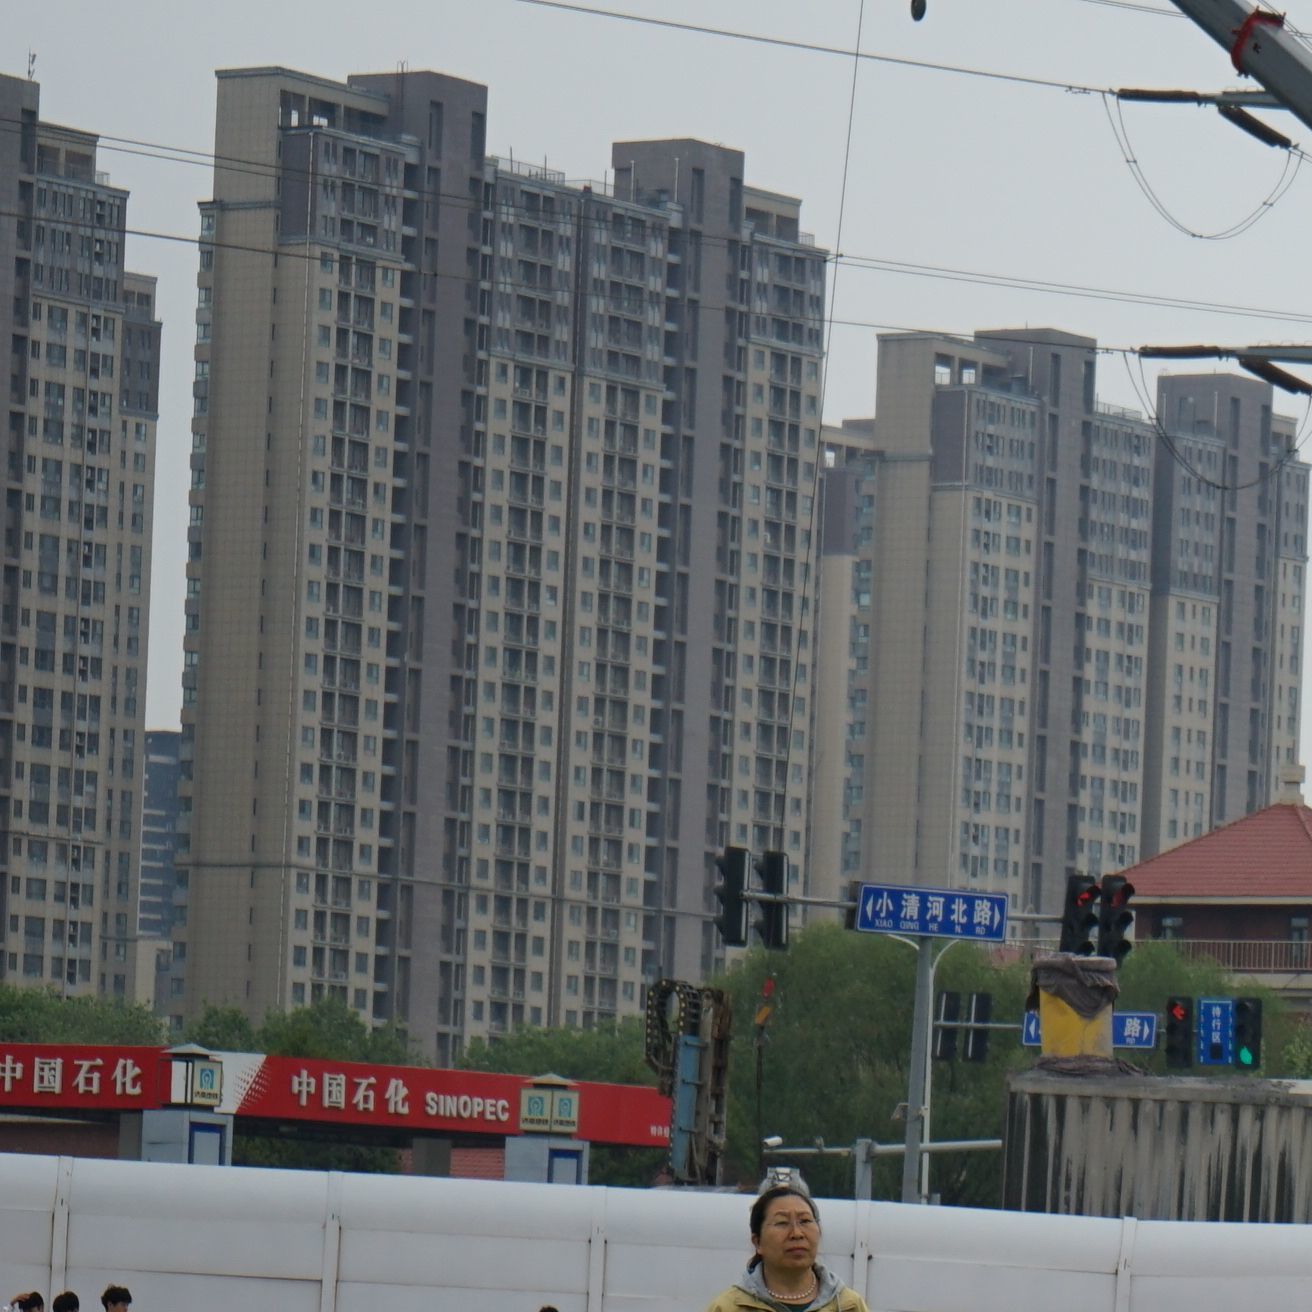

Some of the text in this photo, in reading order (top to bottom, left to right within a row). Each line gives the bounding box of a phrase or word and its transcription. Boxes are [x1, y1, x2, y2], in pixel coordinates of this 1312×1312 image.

[875, 919, 893, 929] XIAO
[900, 920, 919, 931] QING
[928, 922, 939, 932] HE
[976, 926, 986, 935] RD
[876, 891, 992, 926] 小清河北路
[0, 1055, 142, 1095] 中国石化
[292, 1069, 509, 1122] 中国石化 SINOPEC
